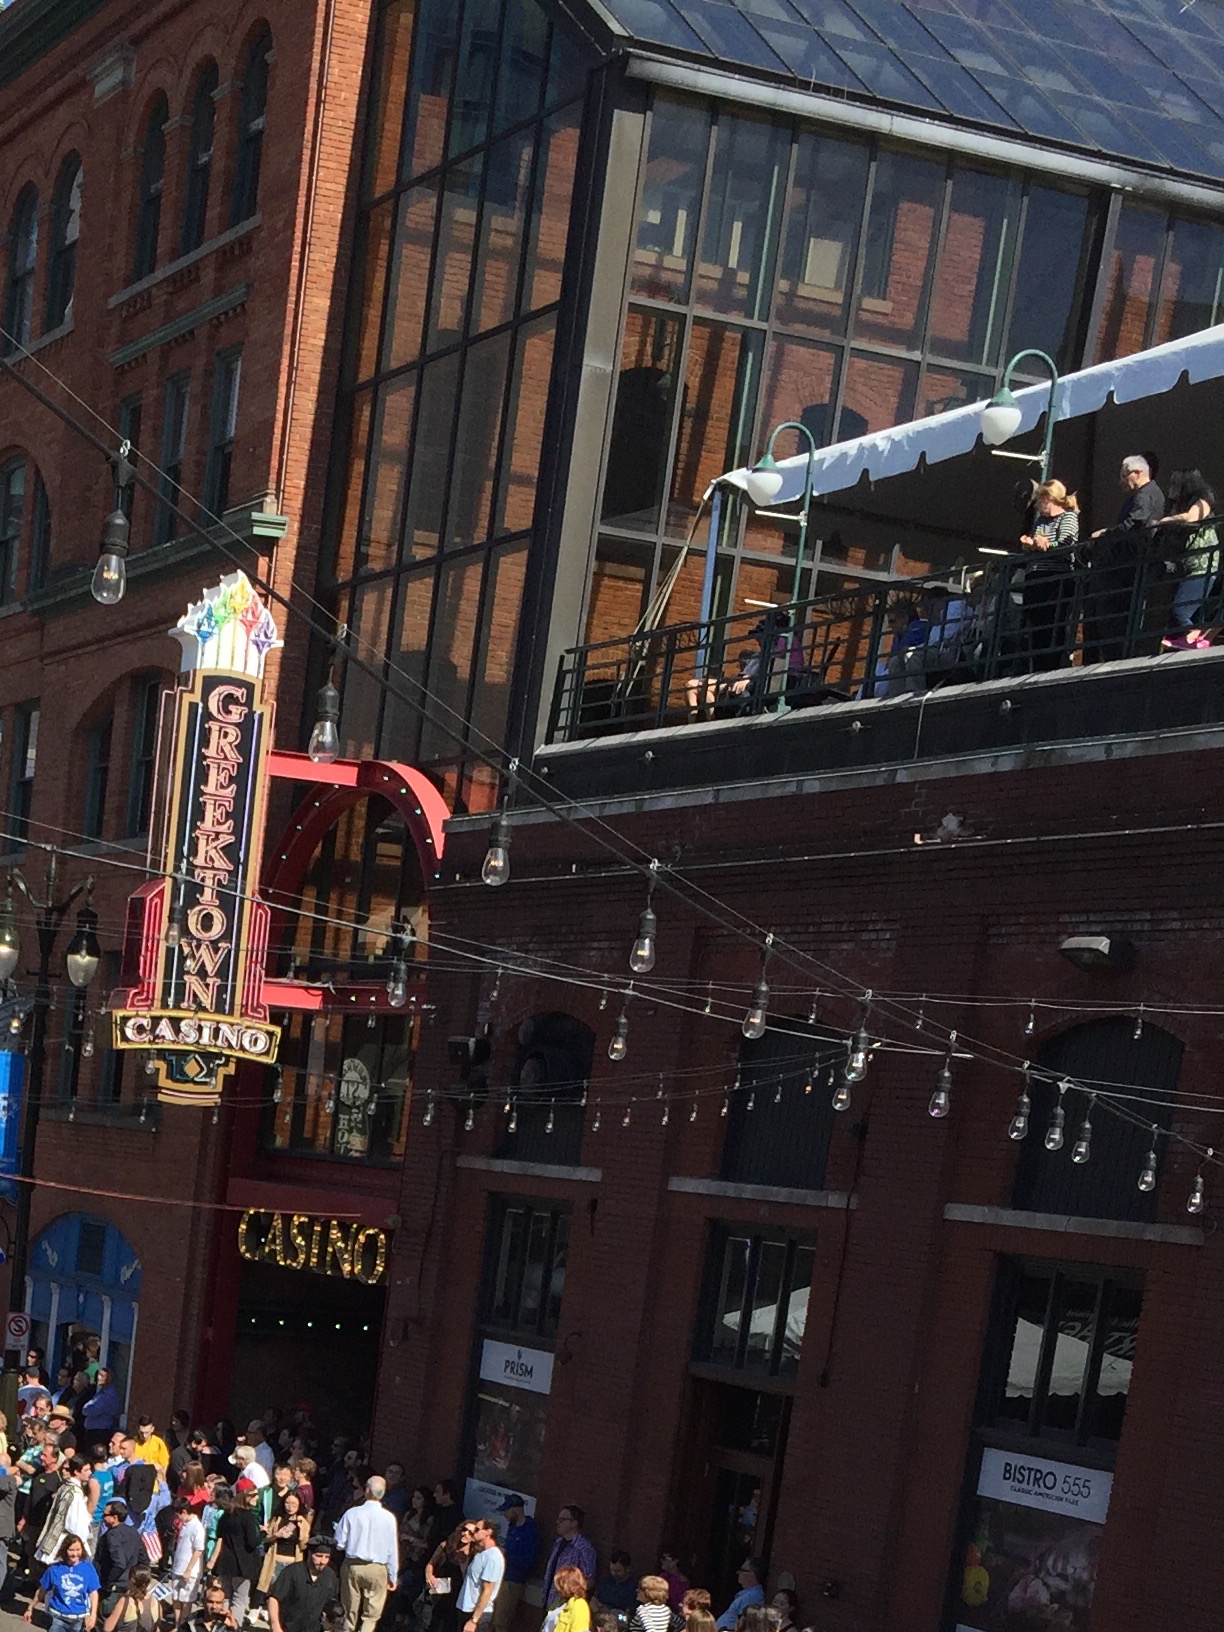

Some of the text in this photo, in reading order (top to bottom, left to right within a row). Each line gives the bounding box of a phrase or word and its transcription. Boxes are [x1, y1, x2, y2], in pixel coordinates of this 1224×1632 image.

[180, 684, 248, 1012] GREEKTOWN
[123, 1016, 271, 1055] CASINO
[238, 1207, 386, 1285] CASINO
[503, 1359, 534, 1379] PRISM
[1002, 1462, 1092, 1499] BISTRO 555
